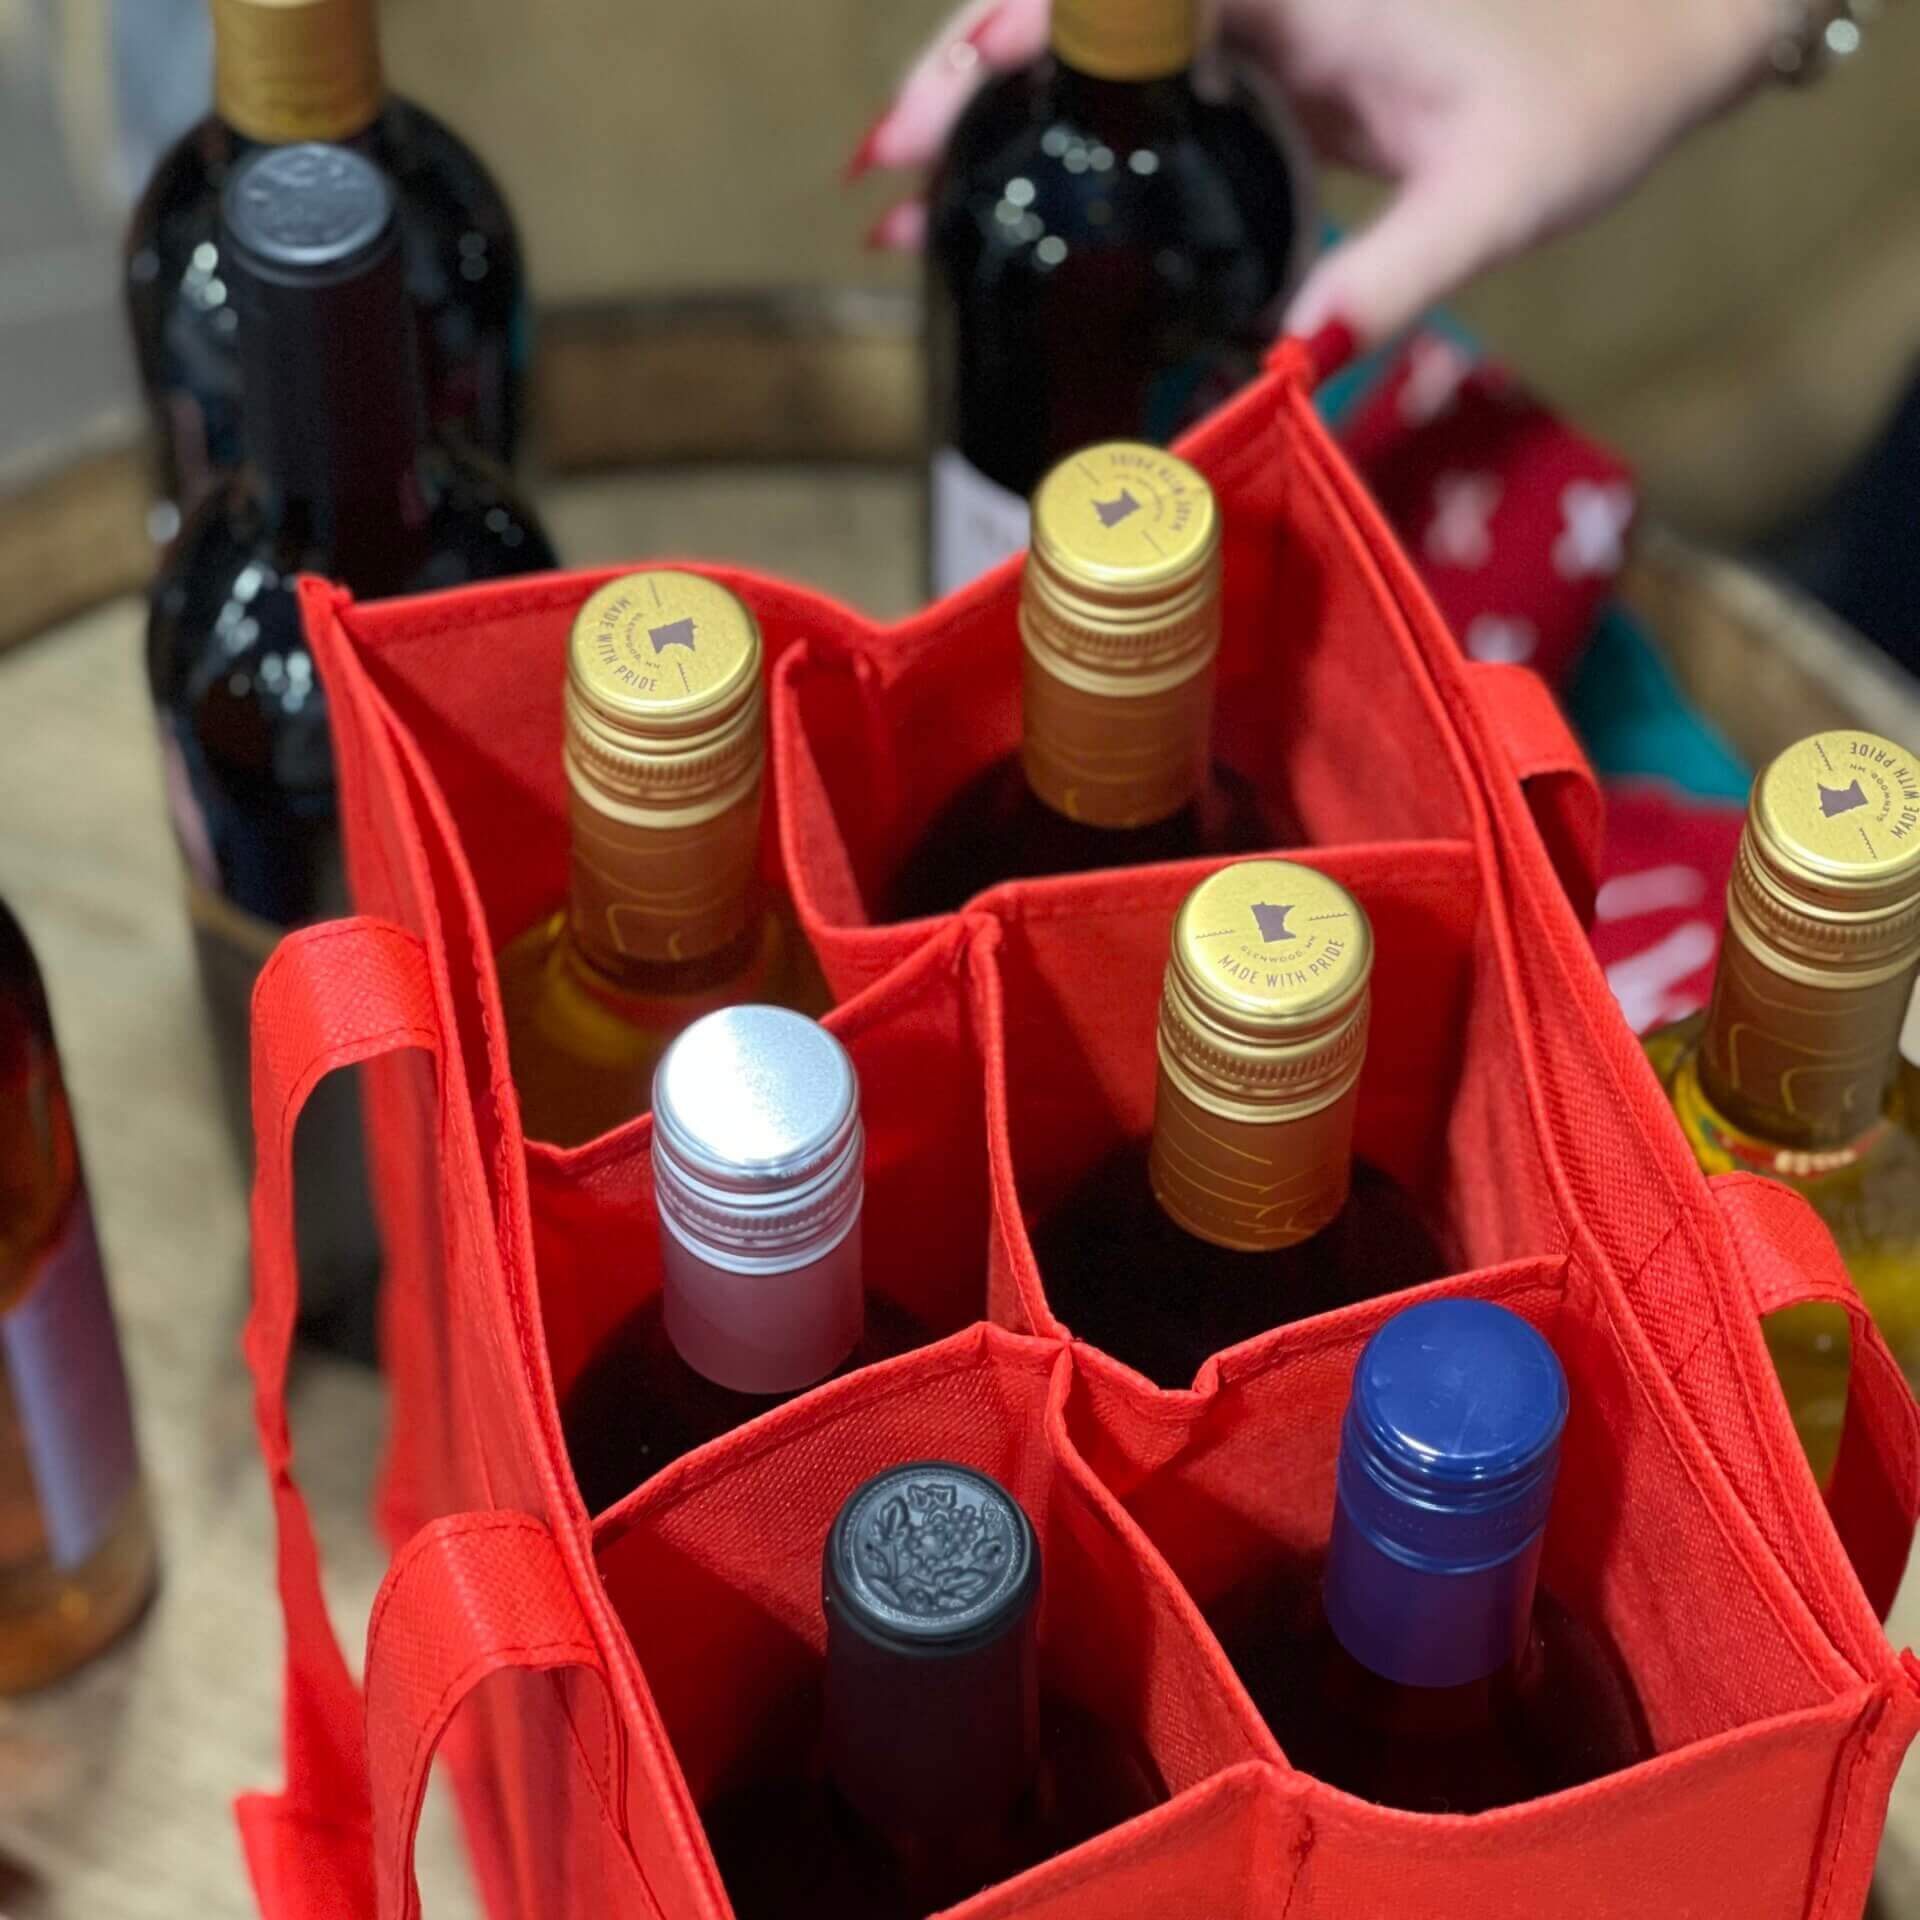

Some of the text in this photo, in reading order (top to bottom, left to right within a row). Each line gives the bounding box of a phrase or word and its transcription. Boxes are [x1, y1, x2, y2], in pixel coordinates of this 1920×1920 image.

[597, 597, 658, 692] MADE WITH PRIDE
[1850, 742, 1920, 839] MADE WITH PRIDE
[1218, 938, 1345, 988] MADE WITH PRIDE
